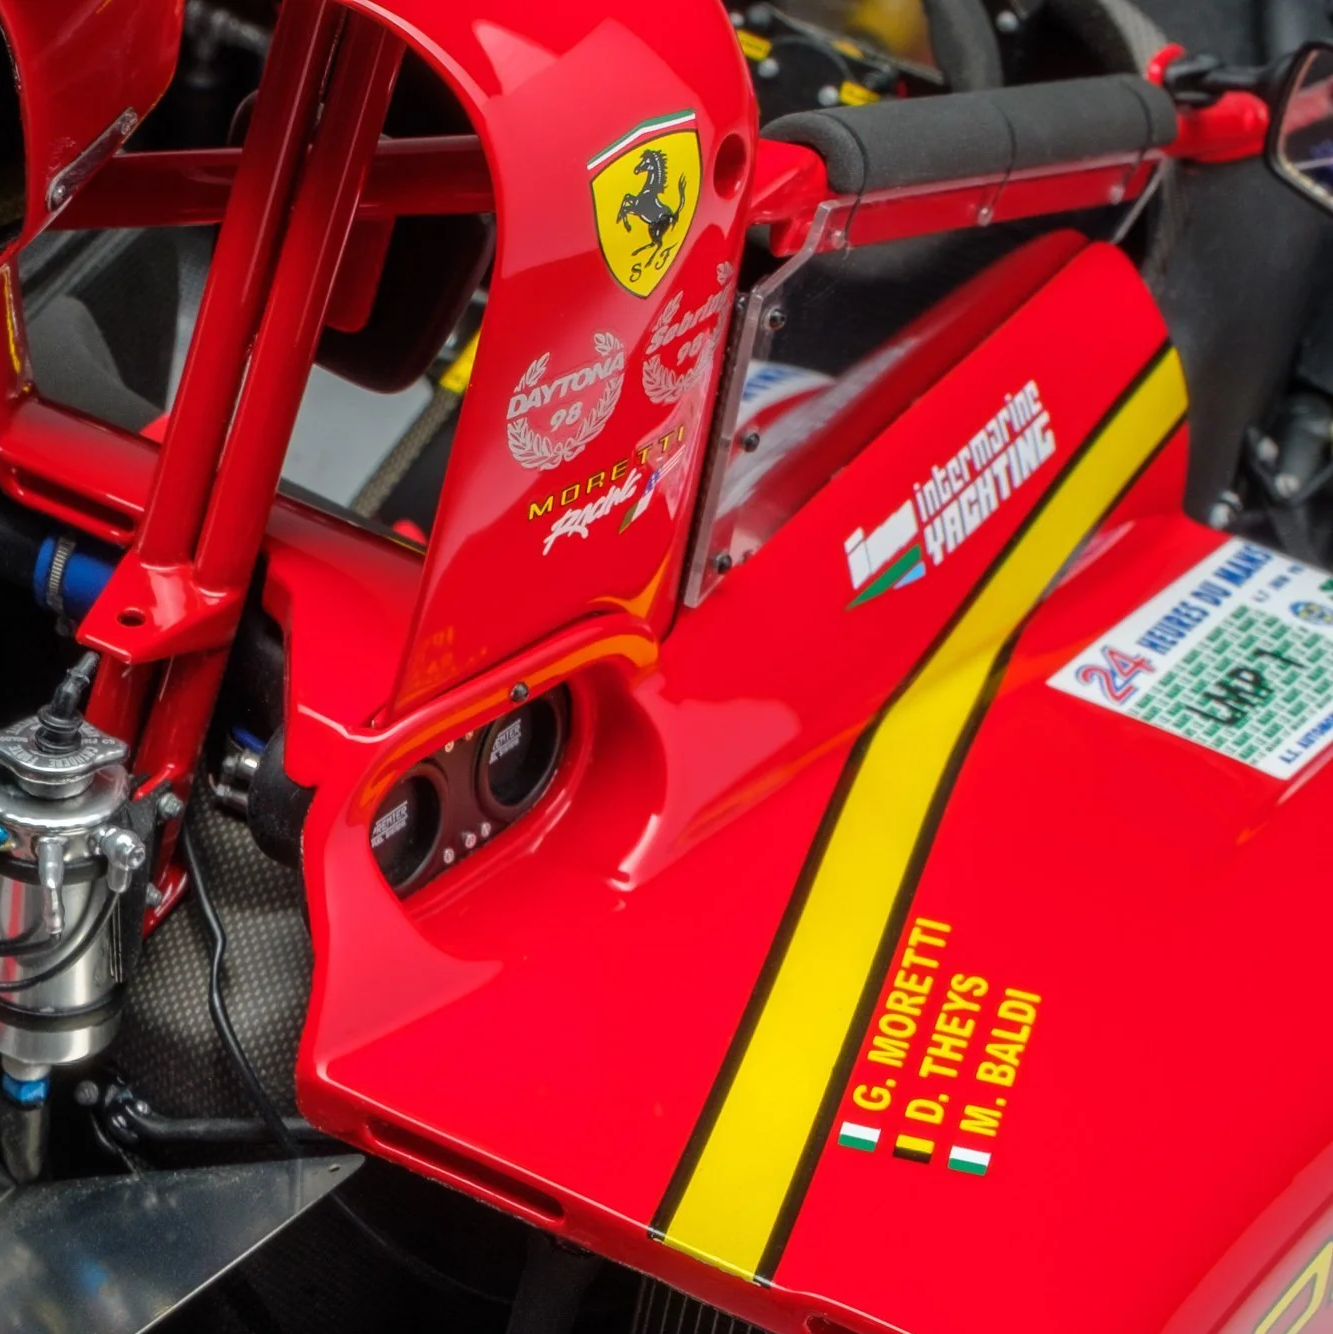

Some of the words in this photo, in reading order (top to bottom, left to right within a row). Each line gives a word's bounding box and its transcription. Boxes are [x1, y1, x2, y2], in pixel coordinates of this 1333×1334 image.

[506, 351, 624, 420] DAYTONA
[550, 401, 583, 432] 98
[527, 424, 687, 521] MORETTI
[912, 378, 1043, 523] intermarine
[923, 409, 1057, 567] YACHTING
[1075, 644, 1156, 704] 24
[1135, 599, 1211, 656] HEURES
[1189, 579, 1233, 607] DU
[867, 917, 952, 1068] MORETTI
[919, 973, 989, 1078] THEYS
[976, 988, 1042, 1088] BALDI
[852, 1079, 897, 1112] G.
[904, 1093, 950, 1125] D.
[959, 1097, 1007, 1137] M.
